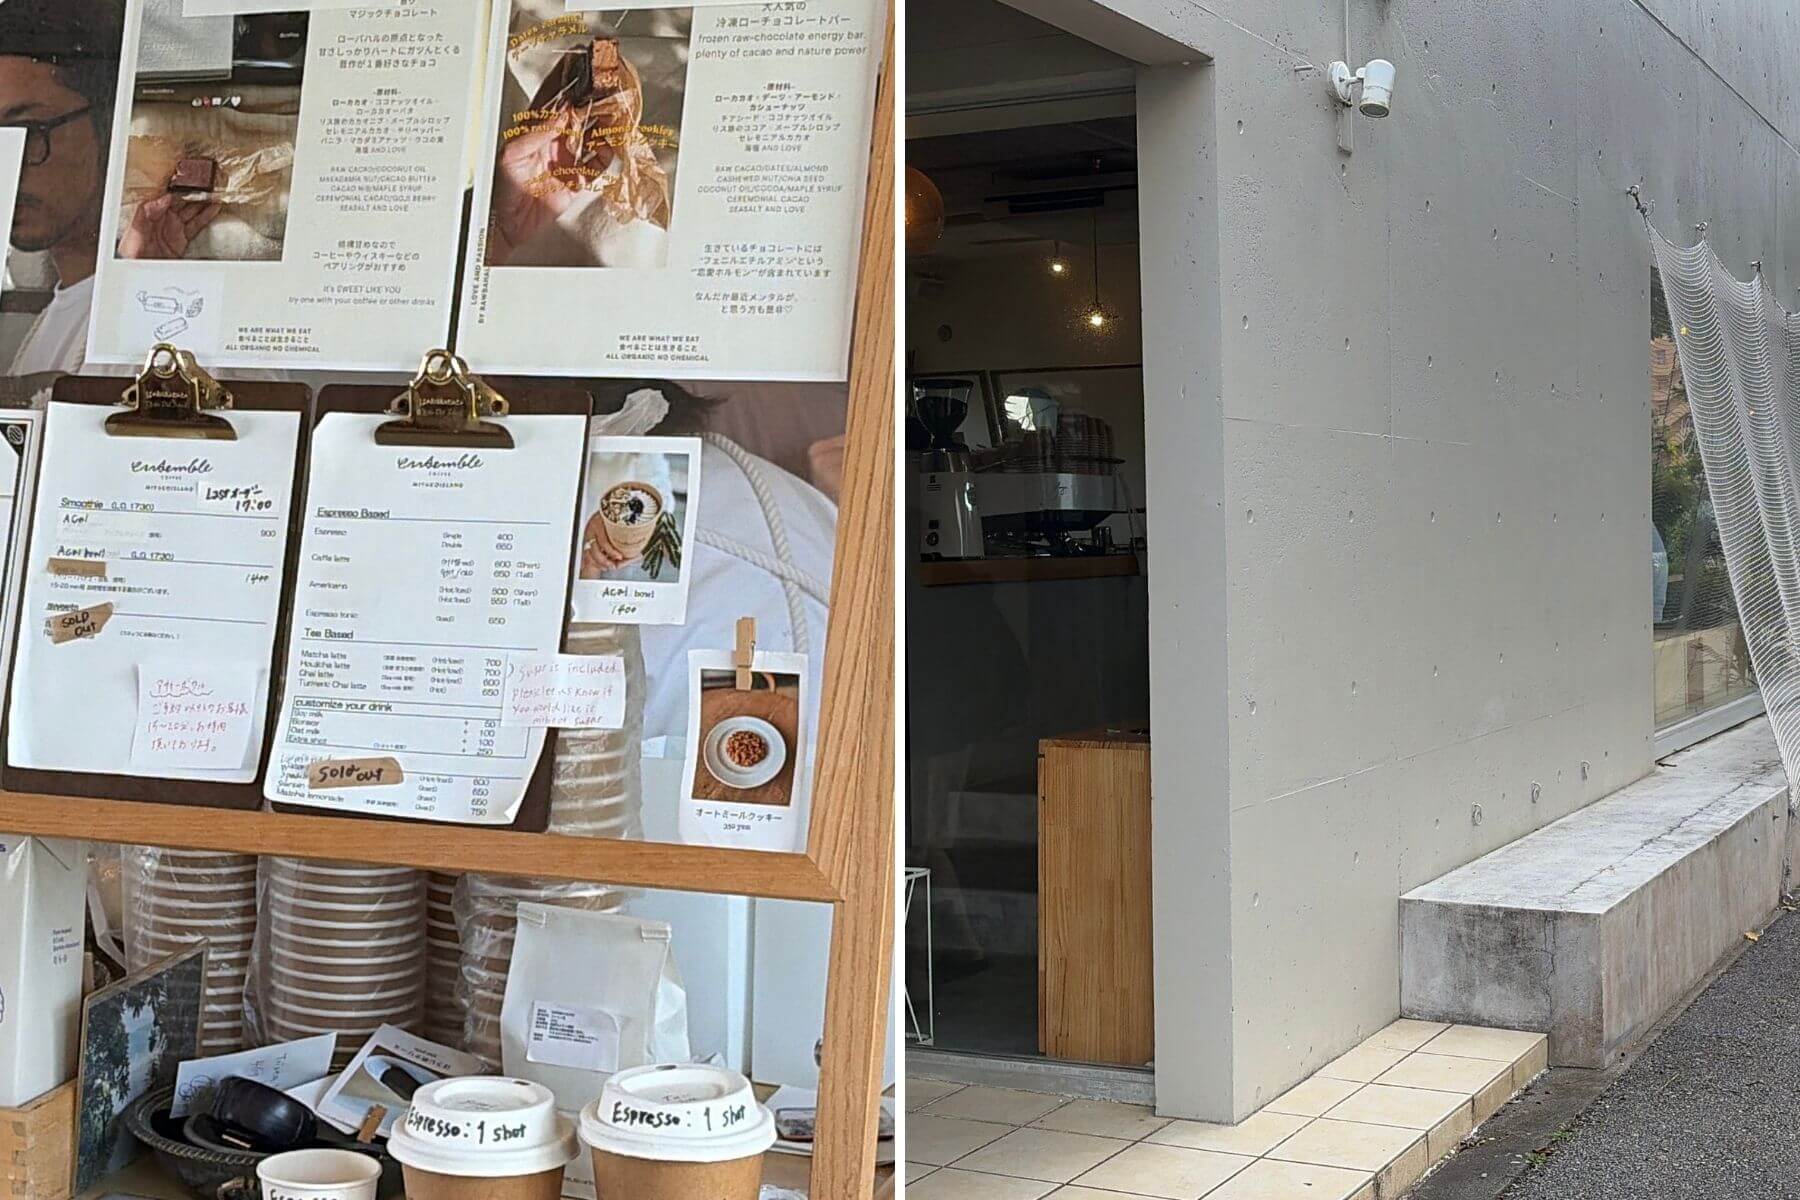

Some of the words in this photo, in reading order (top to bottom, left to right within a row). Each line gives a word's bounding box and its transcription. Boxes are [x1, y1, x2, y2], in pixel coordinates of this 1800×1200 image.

[699, 34, 729, 43] frozen
[732, 32, 804, 42] raw-chocolate
[808, 32, 844, 42] energy
[696, 49, 727, 60] plenty
[729, 49, 740, 58] of
[743, 49, 772, 57] cacao
[775, 47, 794, 56] and
[797, 47, 831, 56] nature
[834, 47, 867, 57] power
[317, 507, 358, 519] Espresso
[361, 509, 391, 520] Based
[485, 658, 501, 667] 700
[484, 668, 500, 677] 700
[295, 700, 343, 709] customize
[345, 702, 366, 713] your
[368, 702, 392, 712] drink
[480, 729, 495, 737] 100
[696, 808, 782, 822] オートミールクッキー
[704, 1107, 711, 1132] 1
[722, 1104, 745, 1128] shot
[477, 1120, 485, 1144] 1
[493, 1123, 527, 1142] shot
